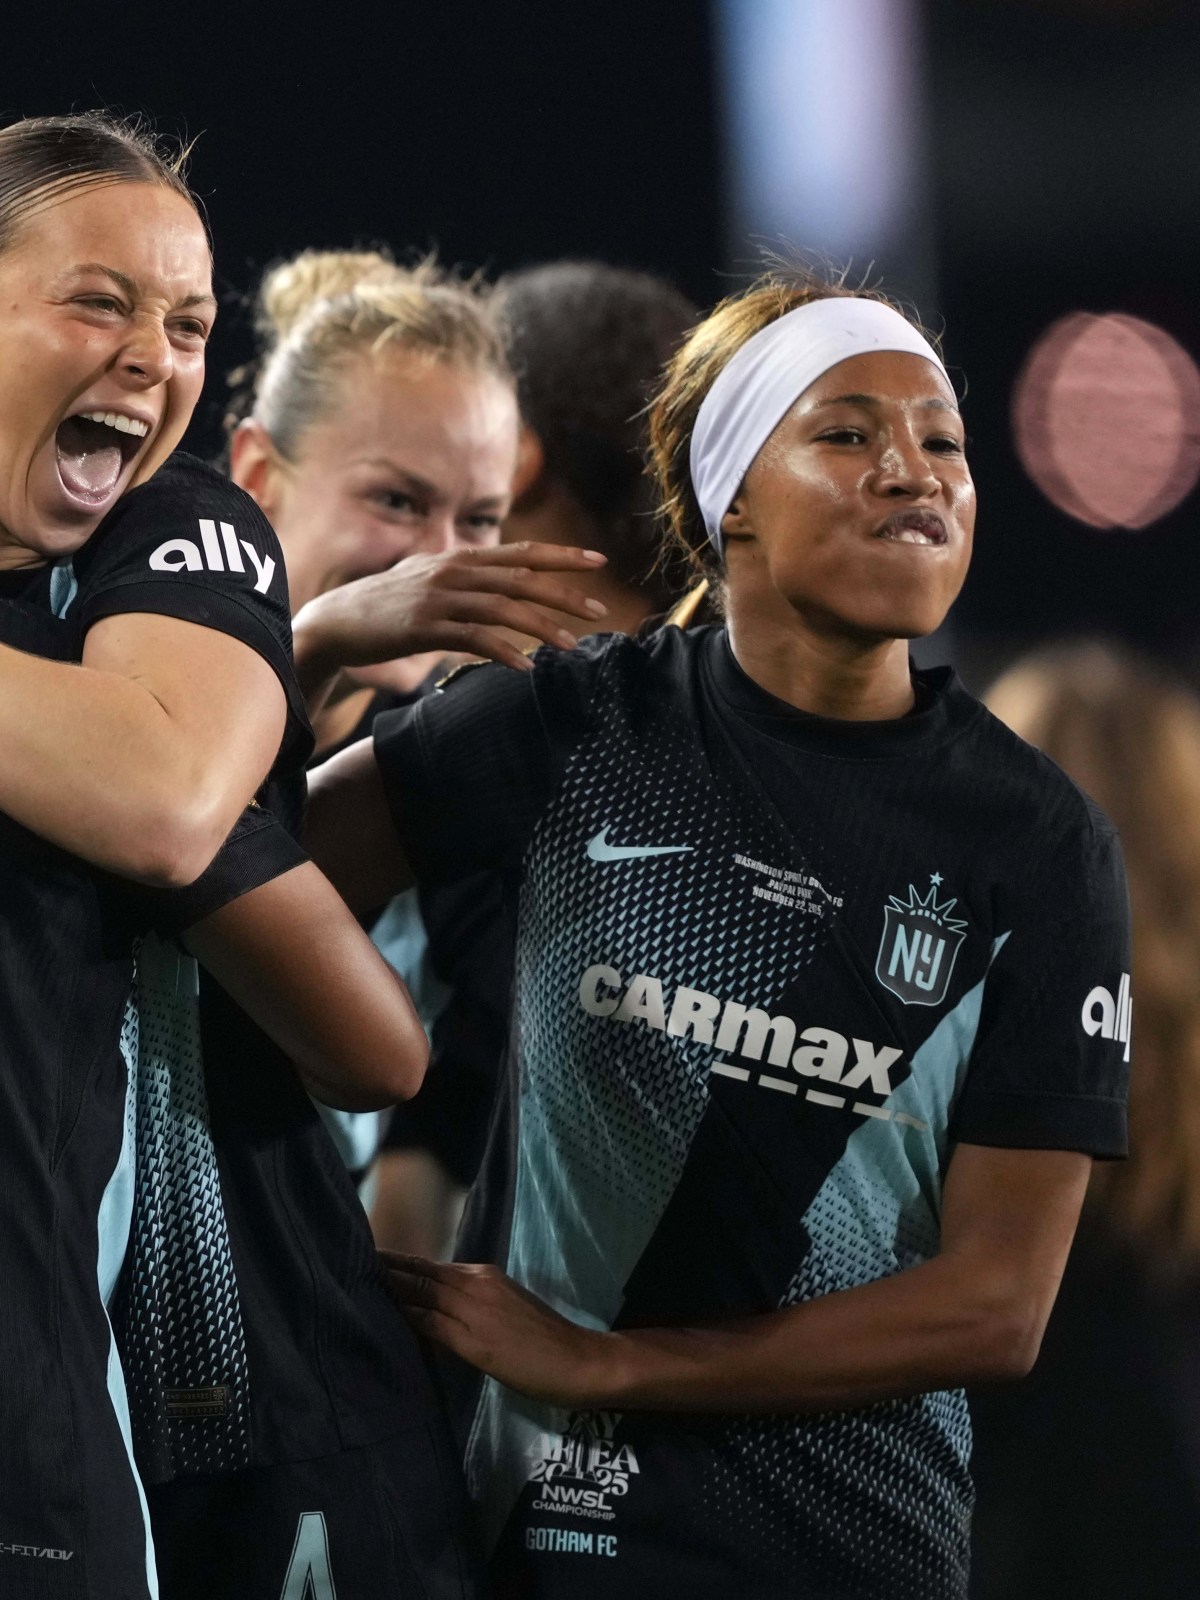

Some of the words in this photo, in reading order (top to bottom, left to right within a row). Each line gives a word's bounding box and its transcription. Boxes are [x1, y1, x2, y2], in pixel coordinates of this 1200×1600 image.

[148, 518, 276, 595] ally
[734, 853, 783, 879] WASHINGTON
[833, 897, 844, 907] FC
[768, 879, 796, 896] PAYPAL
[752, 885, 794, 907] NOVEMBER
[887, 923, 947, 991] NY
[532, 1500, 616, 1521] CHAMPIONSHIP
[541, 1483, 613, 1510] NWSL
[525, 1527, 594, 1554] GOTHAM
[597, 1534, 618, 1557] FC
